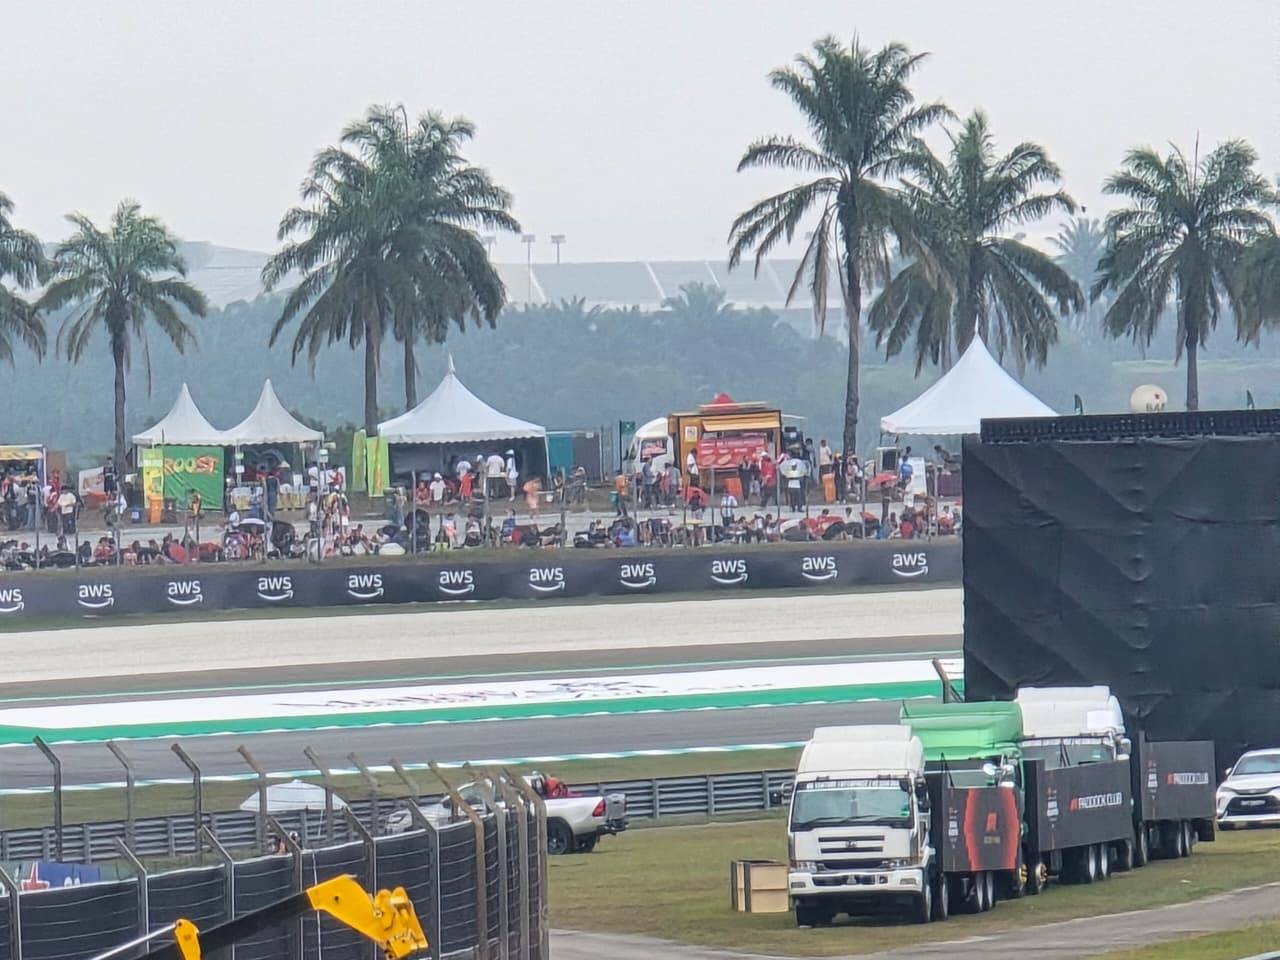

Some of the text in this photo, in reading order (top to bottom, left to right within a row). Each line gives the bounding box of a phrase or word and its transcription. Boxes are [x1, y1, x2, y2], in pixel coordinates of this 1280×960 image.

[711, 560, 746, 574] aws
[802, 557, 835, 571] aws
[893, 553, 926, 567] aws
[440, 570, 473, 584] aws
[530, 568, 563, 582] aws
[621, 564, 654, 578] aws
[168, 581, 200, 595] aws
[258, 577, 291, 591] aws
[349, 574, 382, 588] aws
[78, 584, 112, 598] aws
